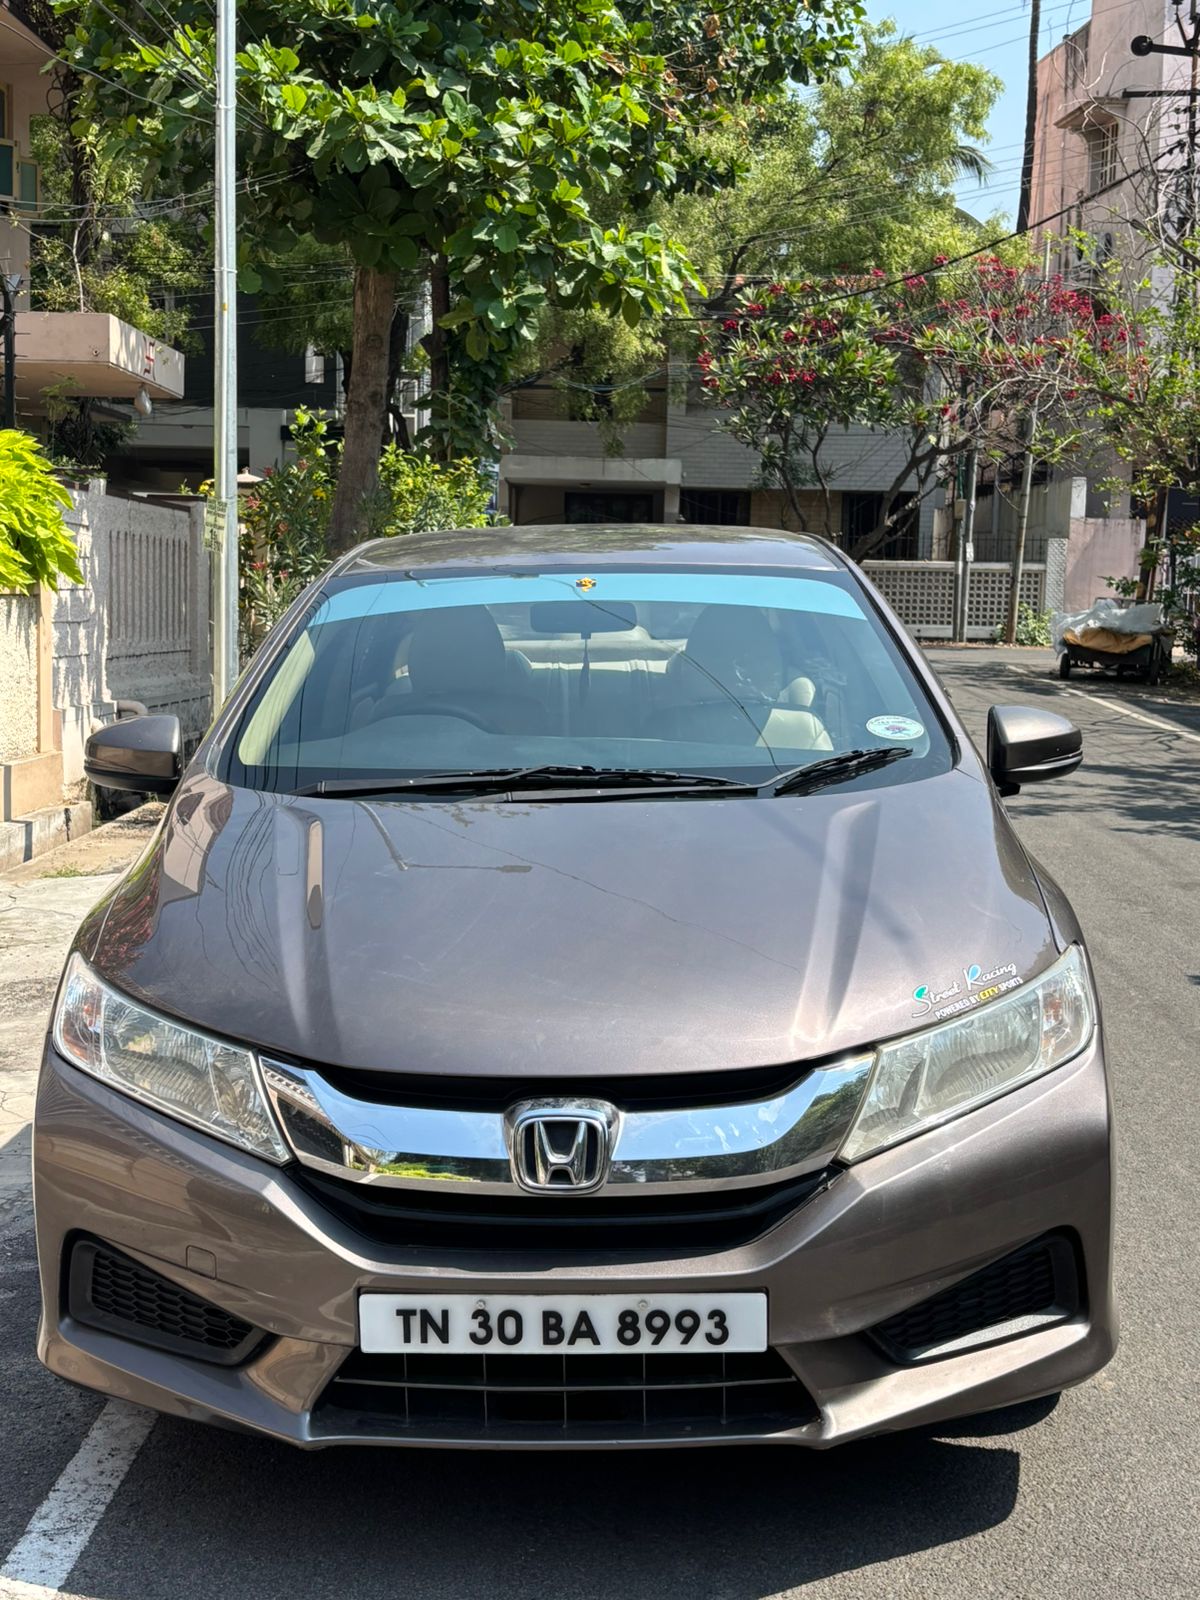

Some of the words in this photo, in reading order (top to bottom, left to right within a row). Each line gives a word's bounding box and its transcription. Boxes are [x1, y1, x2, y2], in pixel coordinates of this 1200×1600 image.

[911, 982, 961, 1018] Street
[963, 964, 1017, 991] Racing
[934, 998, 970, 1019] POWERED
[969, 994, 981, 1004] BY
[980, 986, 999, 1000] CITY
[396, 1309, 449, 1345] TN
[468, 1308, 524, 1346] 30
[541, 1310, 601, 1346] BA
[616, 1308, 730, 1346] 8993
